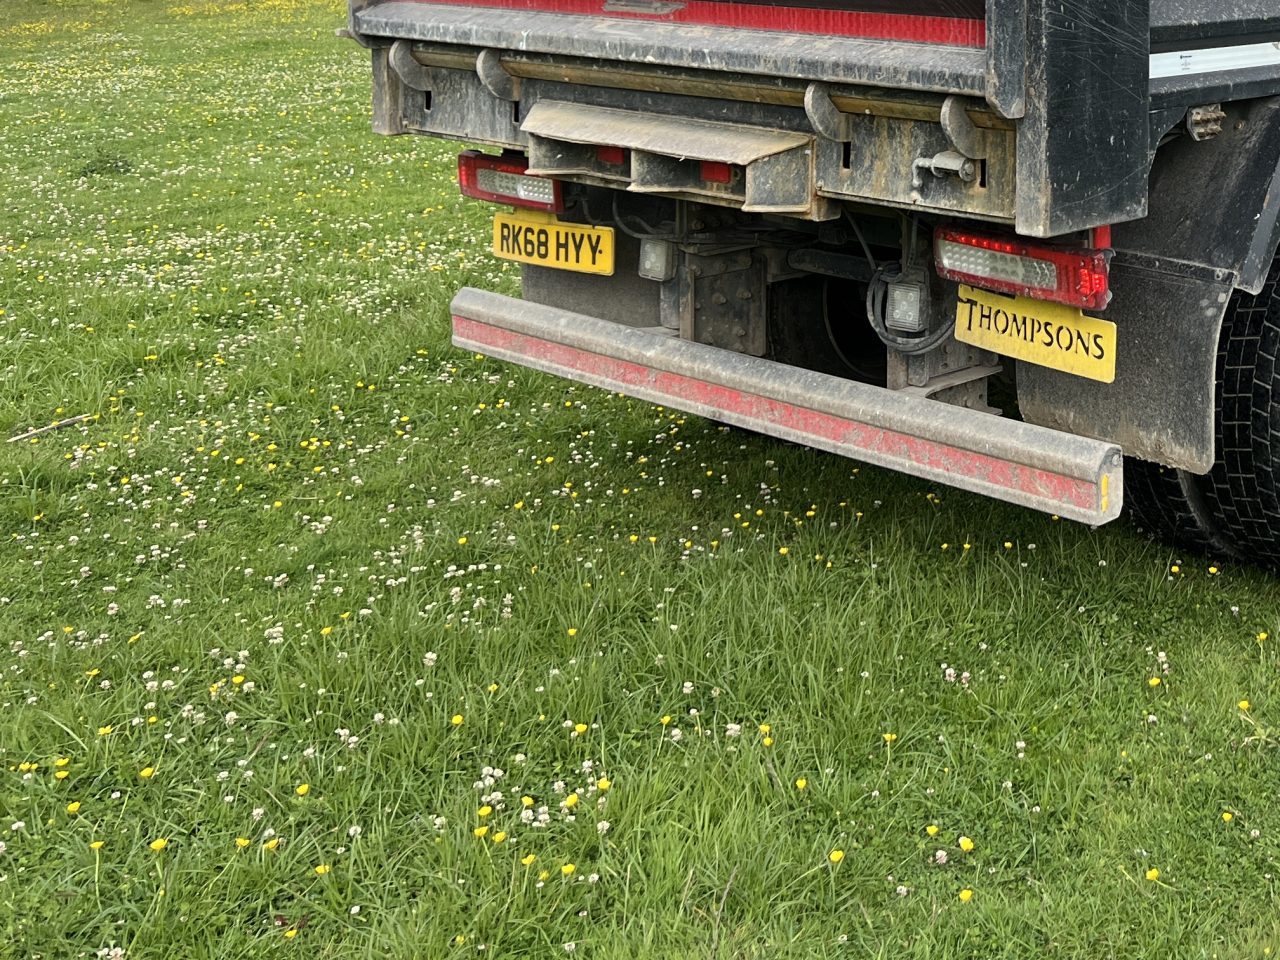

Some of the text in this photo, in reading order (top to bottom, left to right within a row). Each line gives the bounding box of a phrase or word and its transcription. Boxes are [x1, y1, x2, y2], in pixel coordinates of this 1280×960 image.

[500, 222, 602, 266] RK68 HYY
[959, 297, 1105, 360] THOMPSONS
